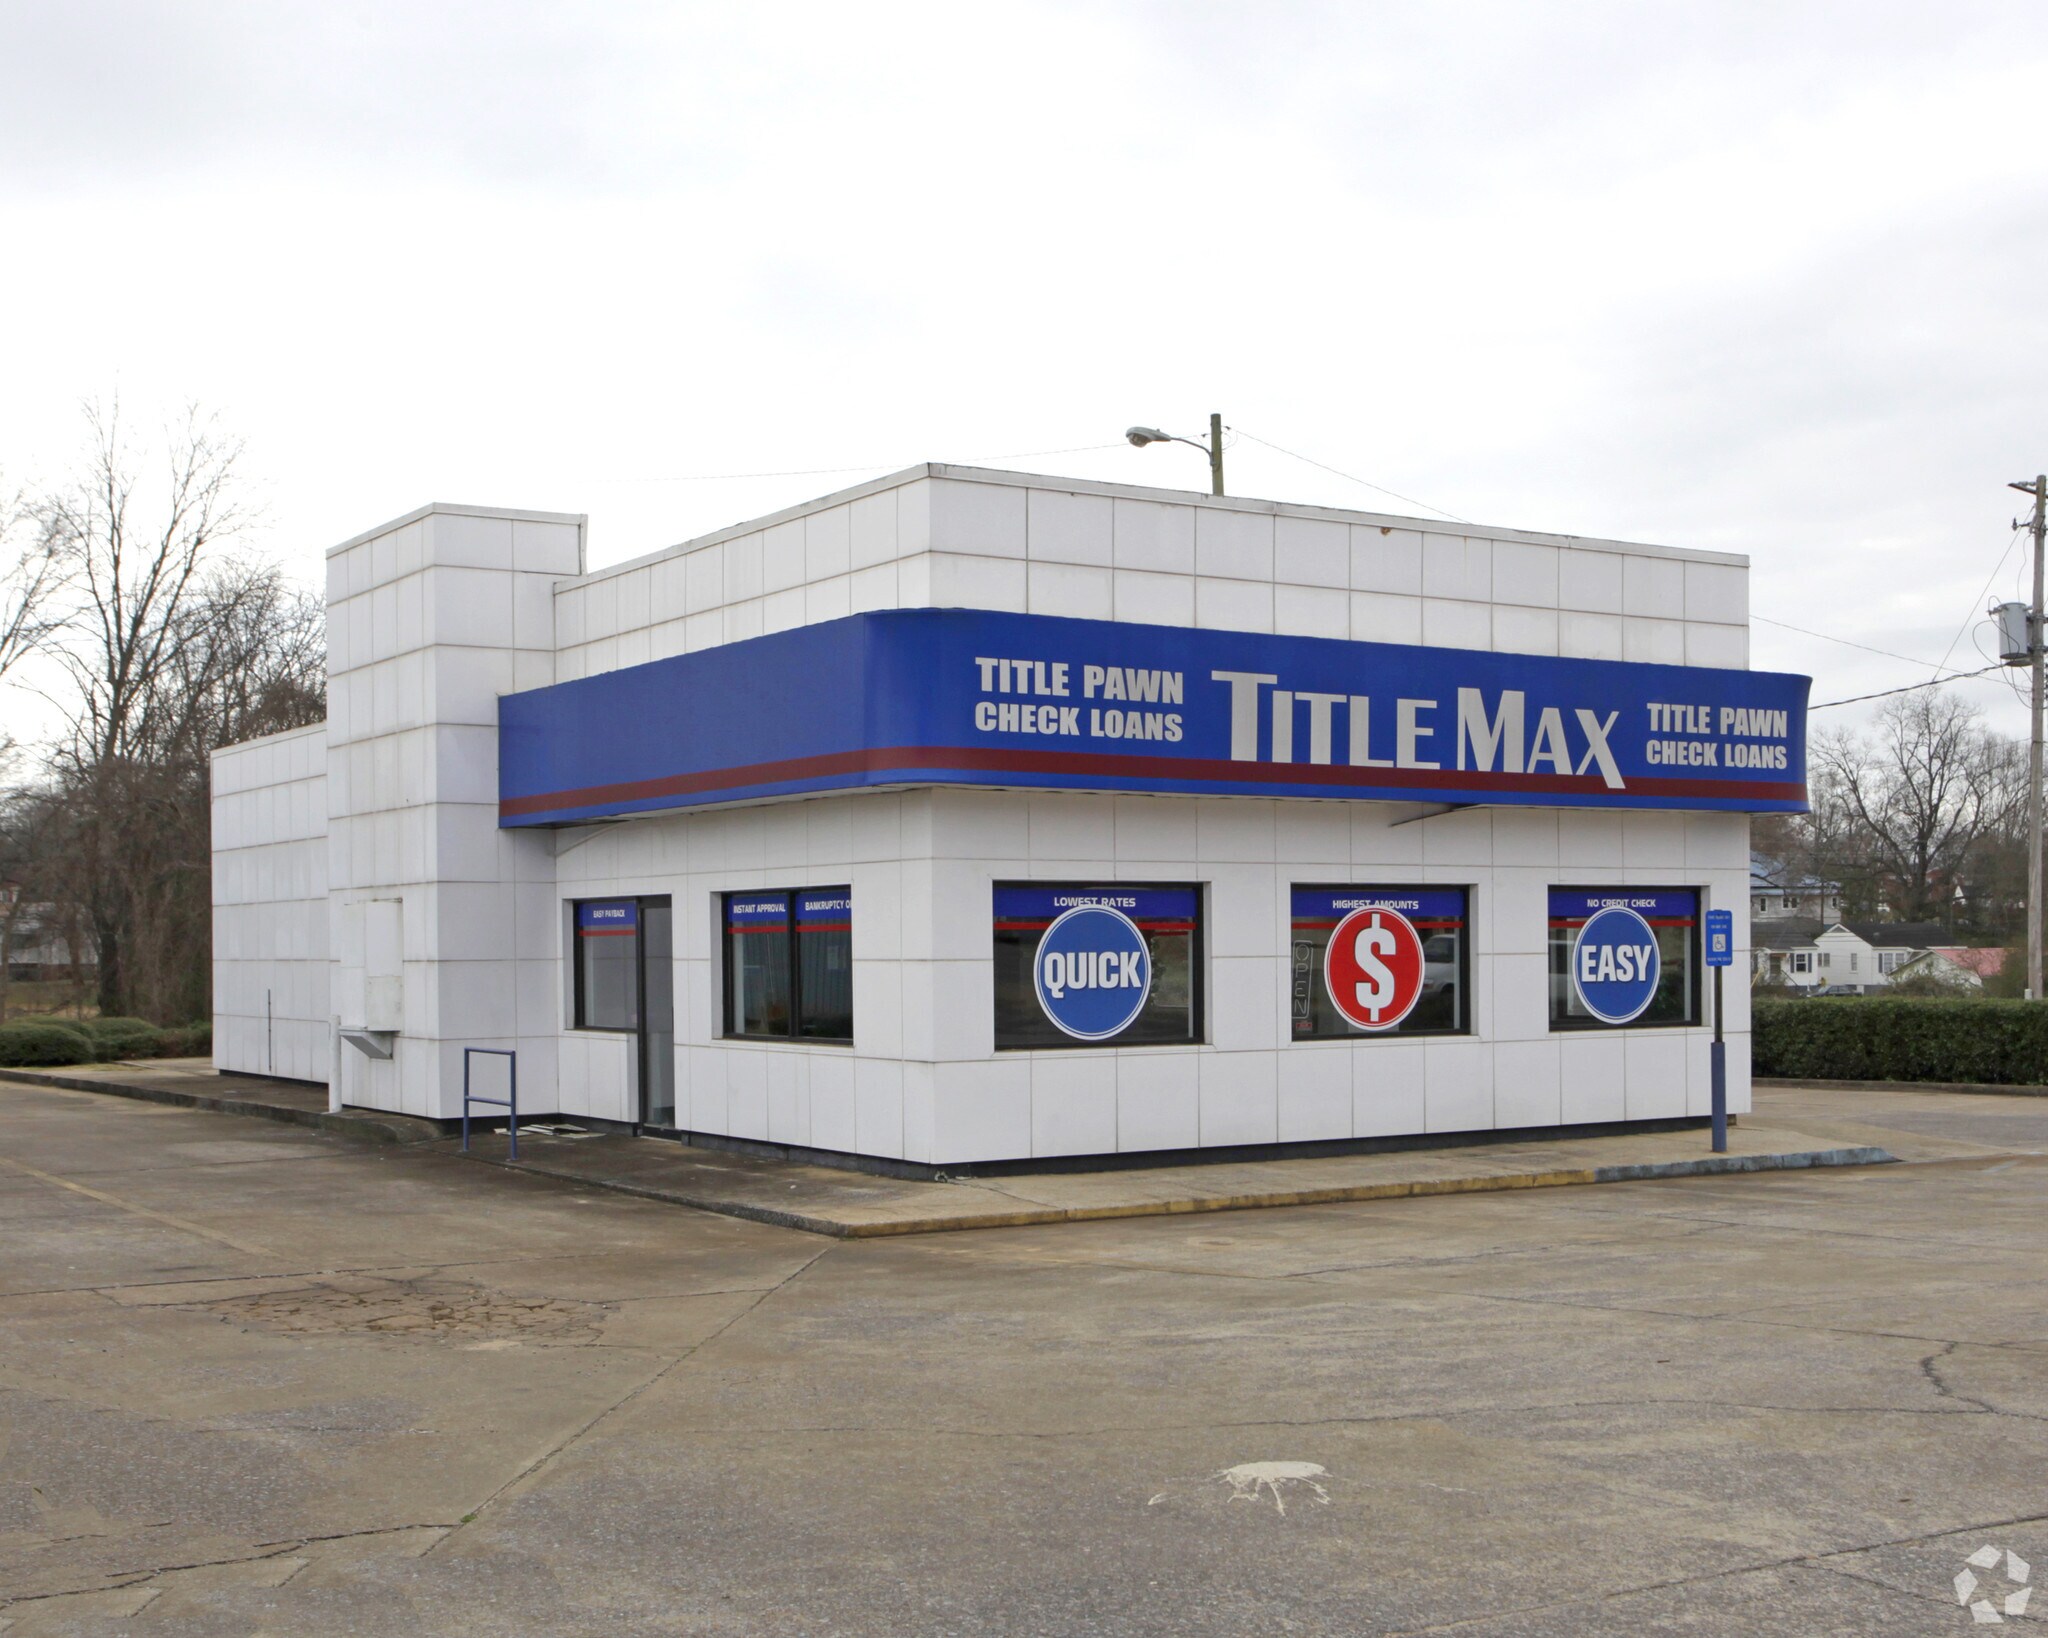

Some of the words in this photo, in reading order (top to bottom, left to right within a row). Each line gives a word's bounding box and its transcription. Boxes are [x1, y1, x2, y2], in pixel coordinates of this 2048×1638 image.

[975, 657, 1070, 697] TITLE
[1083, 664, 1183, 705] PAWN
[975, 701, 1080, 736] CHECK
[1090, 708, 1183, 743] LOANS
[1646, 702, 1711, 734] TITLE
[1720, 707, 1788, 738] PAWN
[1646, 739, 1718, 767] CHECK
[1725, 743, 1788, 770] LOANS
[593, 910, 605, 918] EASY
[605, 909, 625, 918] PAYBACK
[733, 904, 756, 914] INSTANT
[756, 903, 786, 913] APPROVAL
[804, 900, 844, 911] BANKRUPTCY
[1054, 897, 1098, 907] LOWEST
[1101, 897, 1136, 907] RATES
[1332, 899, 1371, 909] HIGHEST
[1374, 900, 1419, 910] AMOUNTS
[1587, 899, 1600, 908] NO
[1601, 899, 1629, 908] CREDIT
[1631, 899, 1656, 908] CHECK
[1044, 951, 1142, 999] QUICK
[1294, 943, 1310, 1015] OPEN
[1581, 944, 1653, 983] EASY
